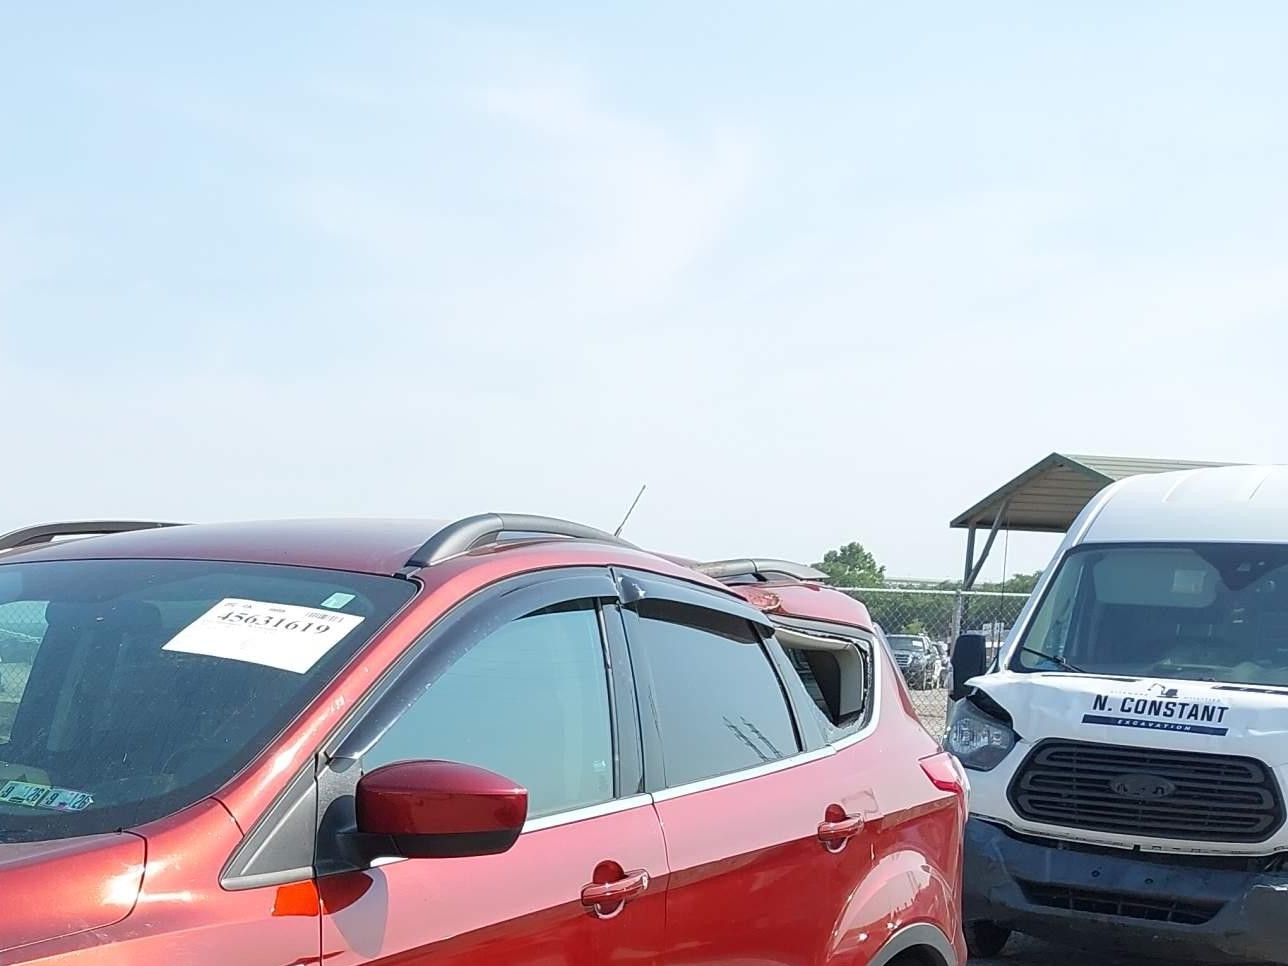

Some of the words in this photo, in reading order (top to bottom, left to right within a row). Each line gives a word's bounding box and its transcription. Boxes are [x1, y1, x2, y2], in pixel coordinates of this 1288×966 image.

[217, 610, 331, 635] 45631619
[1092, 694, 1113, 712] N.
[1120, 696, 1230, 723] CONSTANT
[1116, 719, 1192, 731] EXCAVATION
